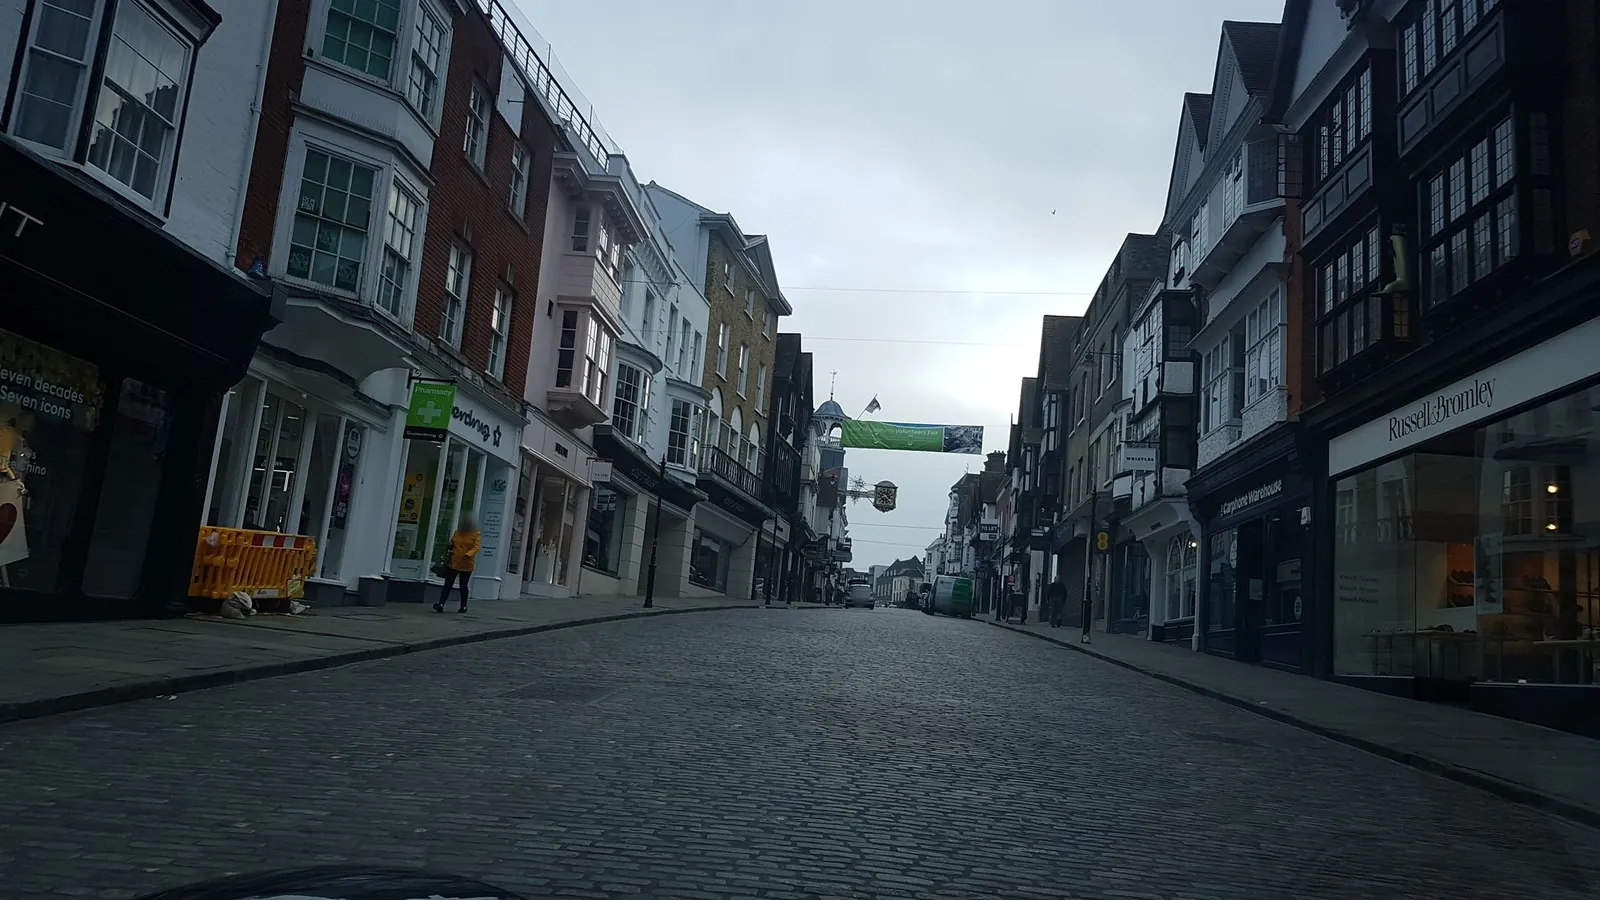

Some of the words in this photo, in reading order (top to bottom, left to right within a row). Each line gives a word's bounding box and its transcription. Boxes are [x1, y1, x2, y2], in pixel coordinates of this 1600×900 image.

[0, 368, 32, 388] even
[34, 377, 85, 404] decades
[0, 385, 38, 410] Seven
[40, 397, 72, 420] icons
[415, 386, 453, 397] Pharmacy
[452, 405, 490, 442] erdrug
[896, 428, 926, 436] Volunteers
[1223, 494, 1248, 515] Carphone
[1248, 479, 1283, 504] Warehouse
